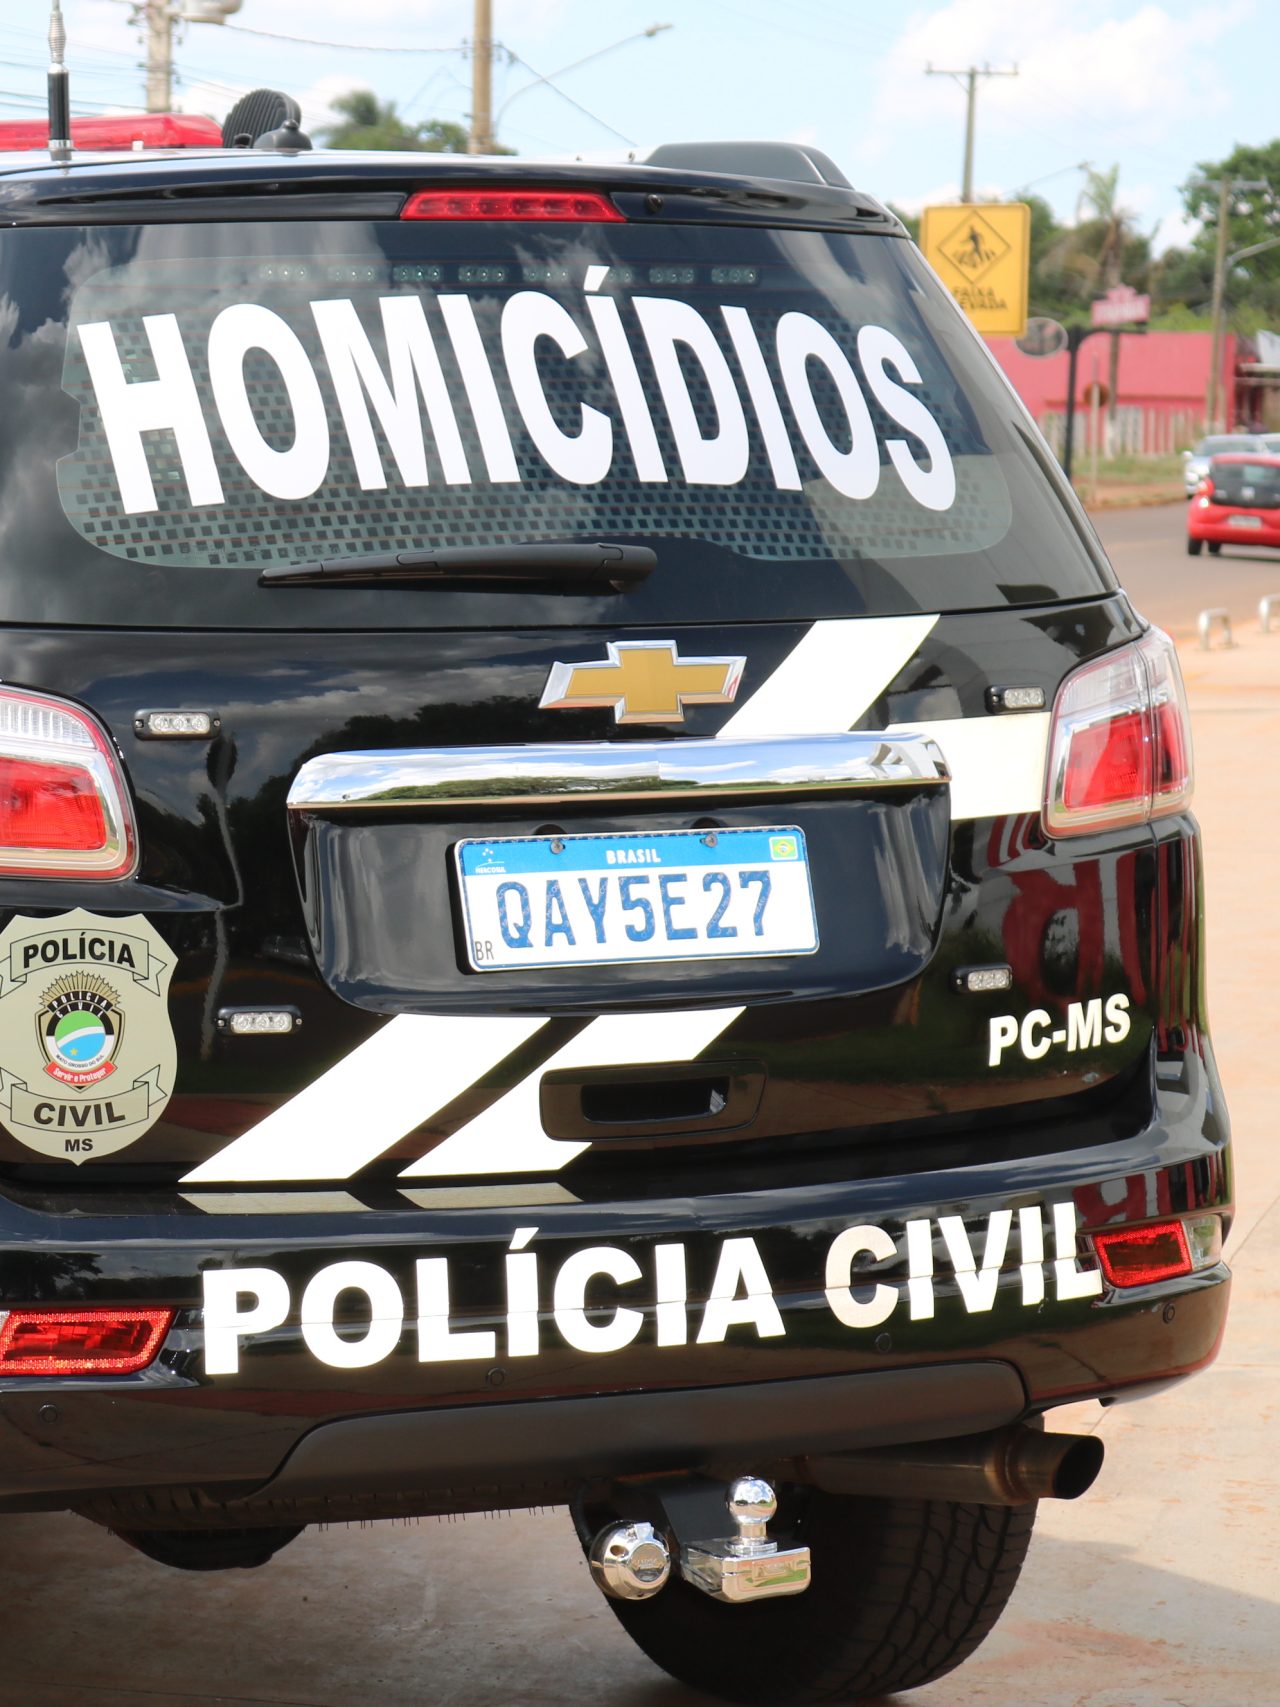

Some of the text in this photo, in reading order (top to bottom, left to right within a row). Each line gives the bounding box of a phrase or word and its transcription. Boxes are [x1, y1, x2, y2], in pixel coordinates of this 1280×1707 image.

[76, 265, 958, 515] HOMICÍDIOS
[605, 849, 661, 865] BRASIL
[495, 870, 773, 949] QAY5E27
[23, 932, 136, 969] POLÍCIA
[475, 941, 495, 962] BR
[56, 1001, 104, 1019] CIVIL
[988, 992, 1131, 1067] PC-MS
[53, 1067, 74, 1081] Servir
[33, 1101, 125, 1127] CIVIL
[64, 1138, 94, 1152] MS
[202, 1202, 1104, 1376] POLÍCIA CIVIL
